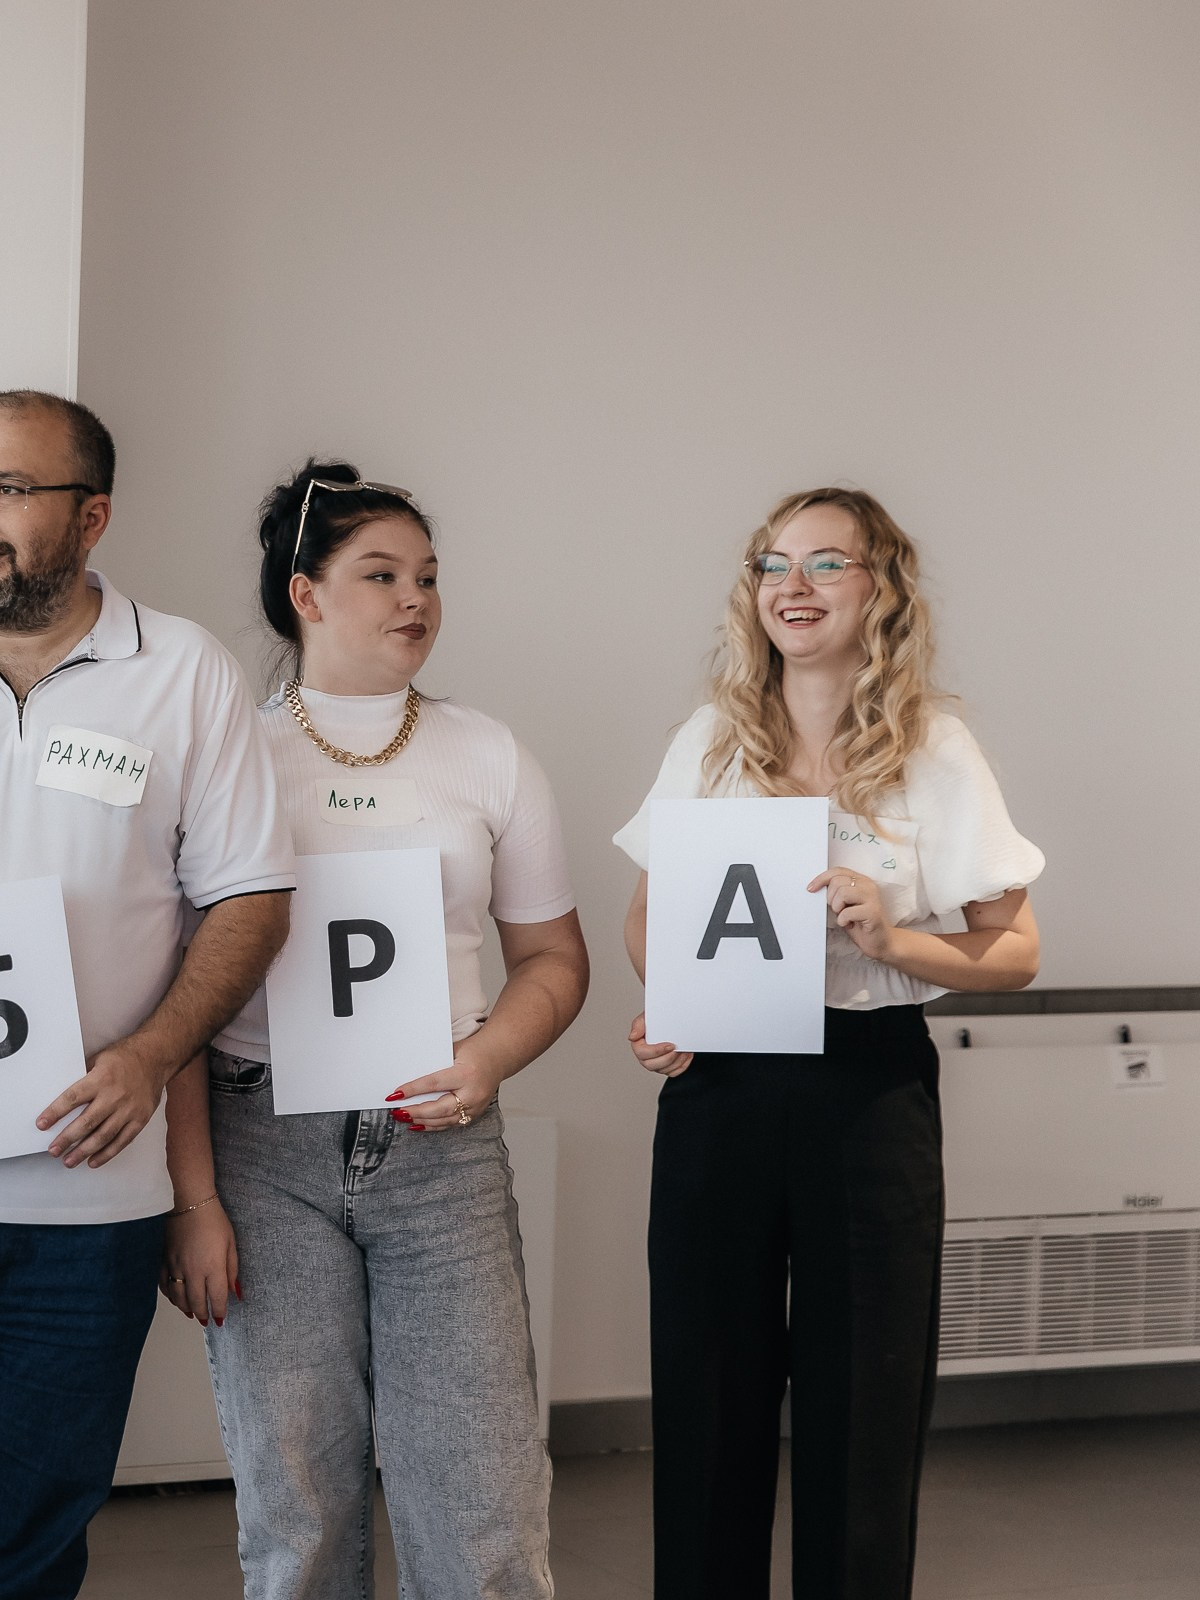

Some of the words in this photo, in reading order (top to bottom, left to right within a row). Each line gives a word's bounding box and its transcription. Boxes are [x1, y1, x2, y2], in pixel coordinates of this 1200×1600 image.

[46, 740, 146, 784] РАХМАН
[696, 863, 784, 961] А
[327, 918, 396, 1018] Р
